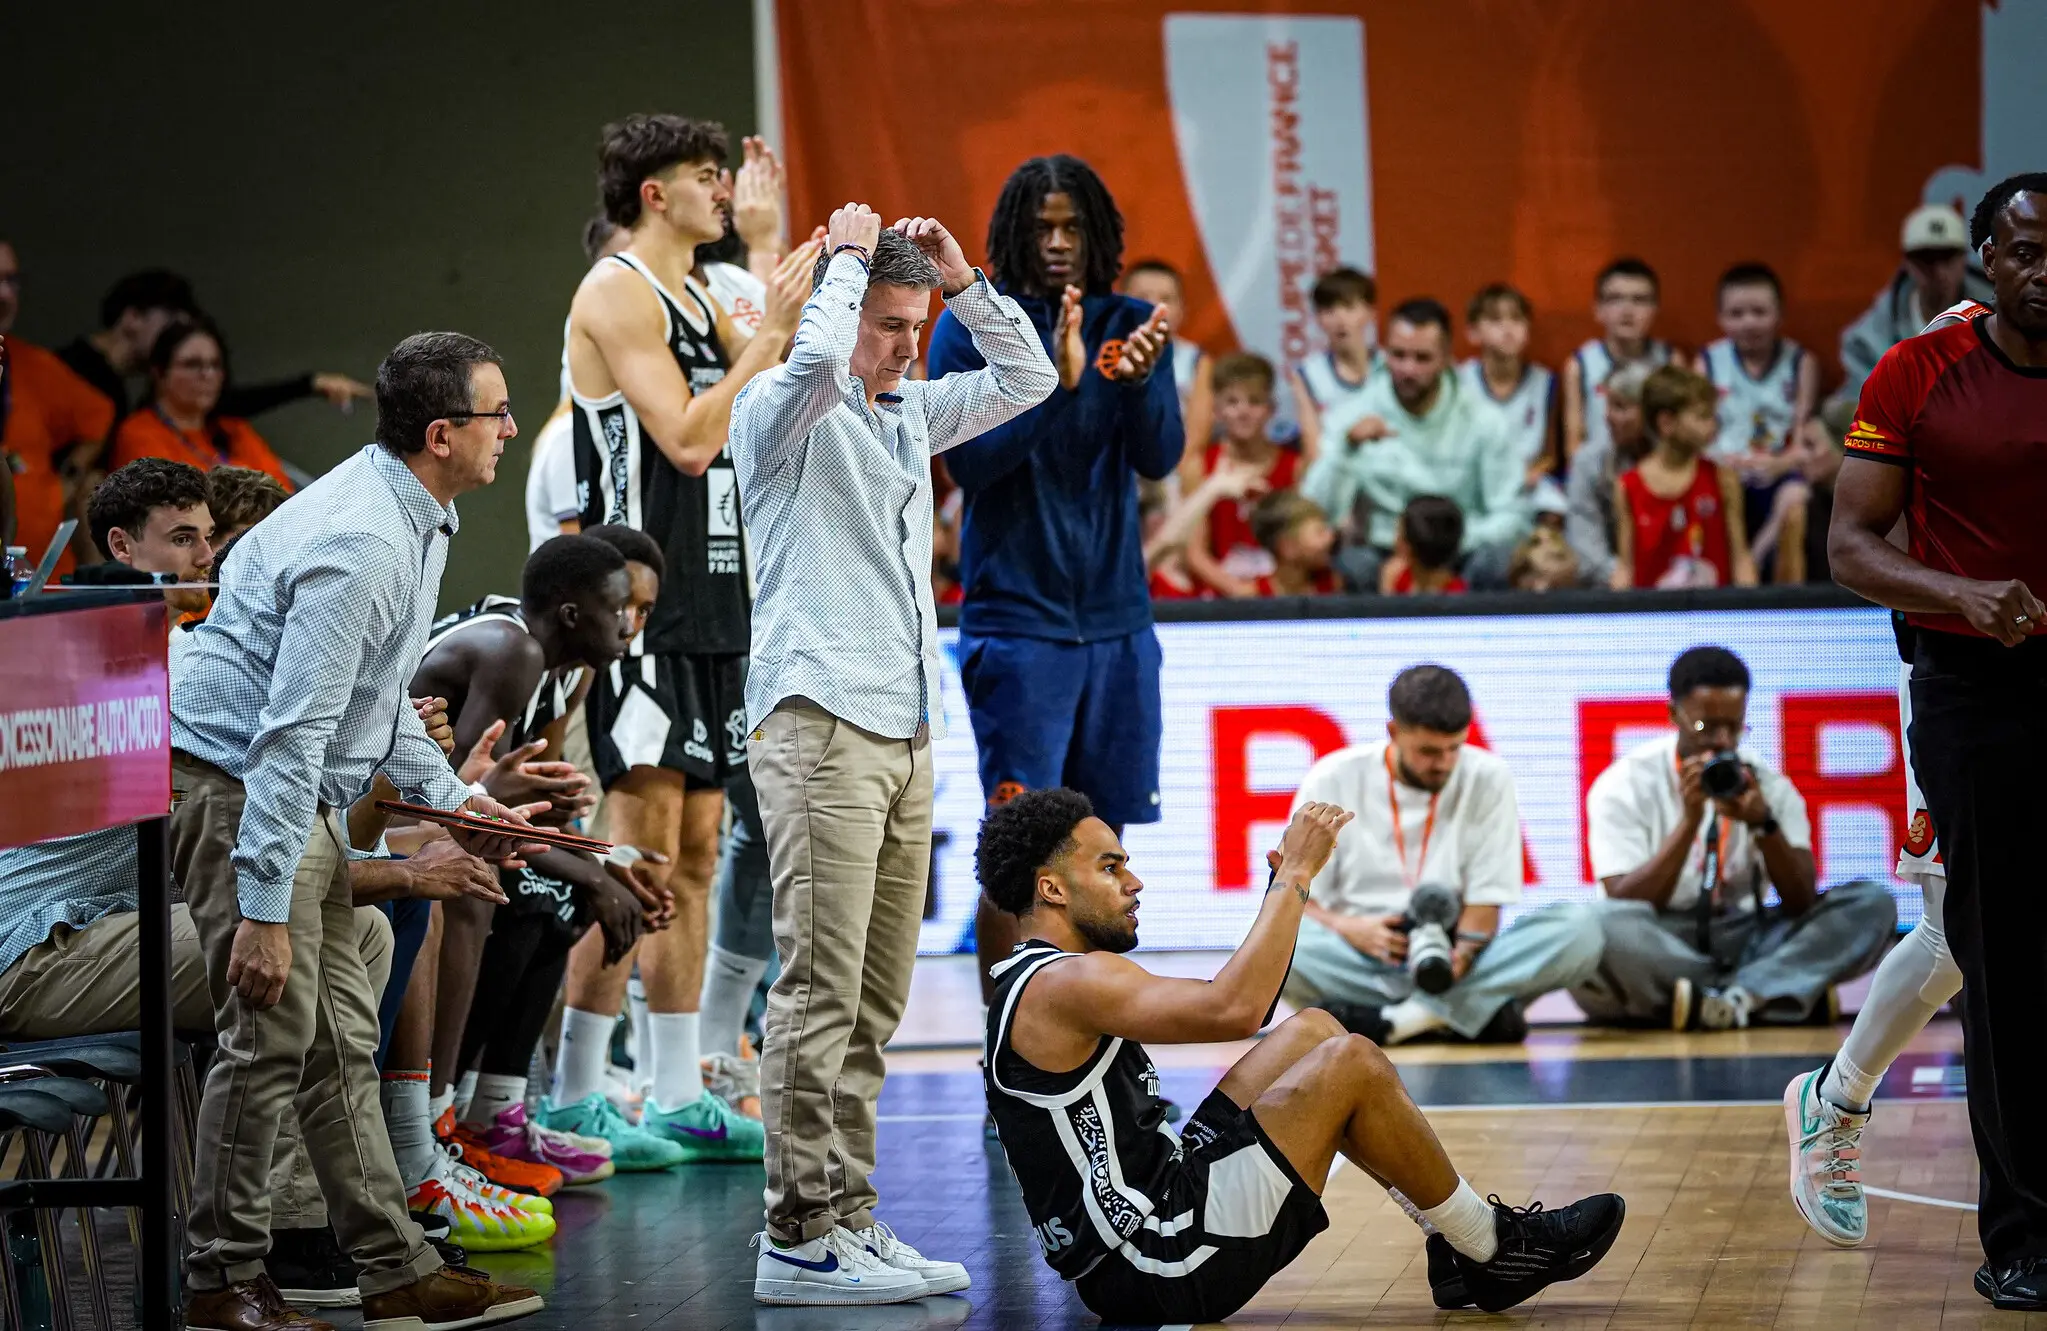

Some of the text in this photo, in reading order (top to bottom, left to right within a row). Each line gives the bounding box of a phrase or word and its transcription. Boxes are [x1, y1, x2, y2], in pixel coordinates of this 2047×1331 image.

[1267, 40, 1302, 195] FRANCE
[97, 698, 127, 756] AUTO
[128, 695, 162, 751] MOTO
